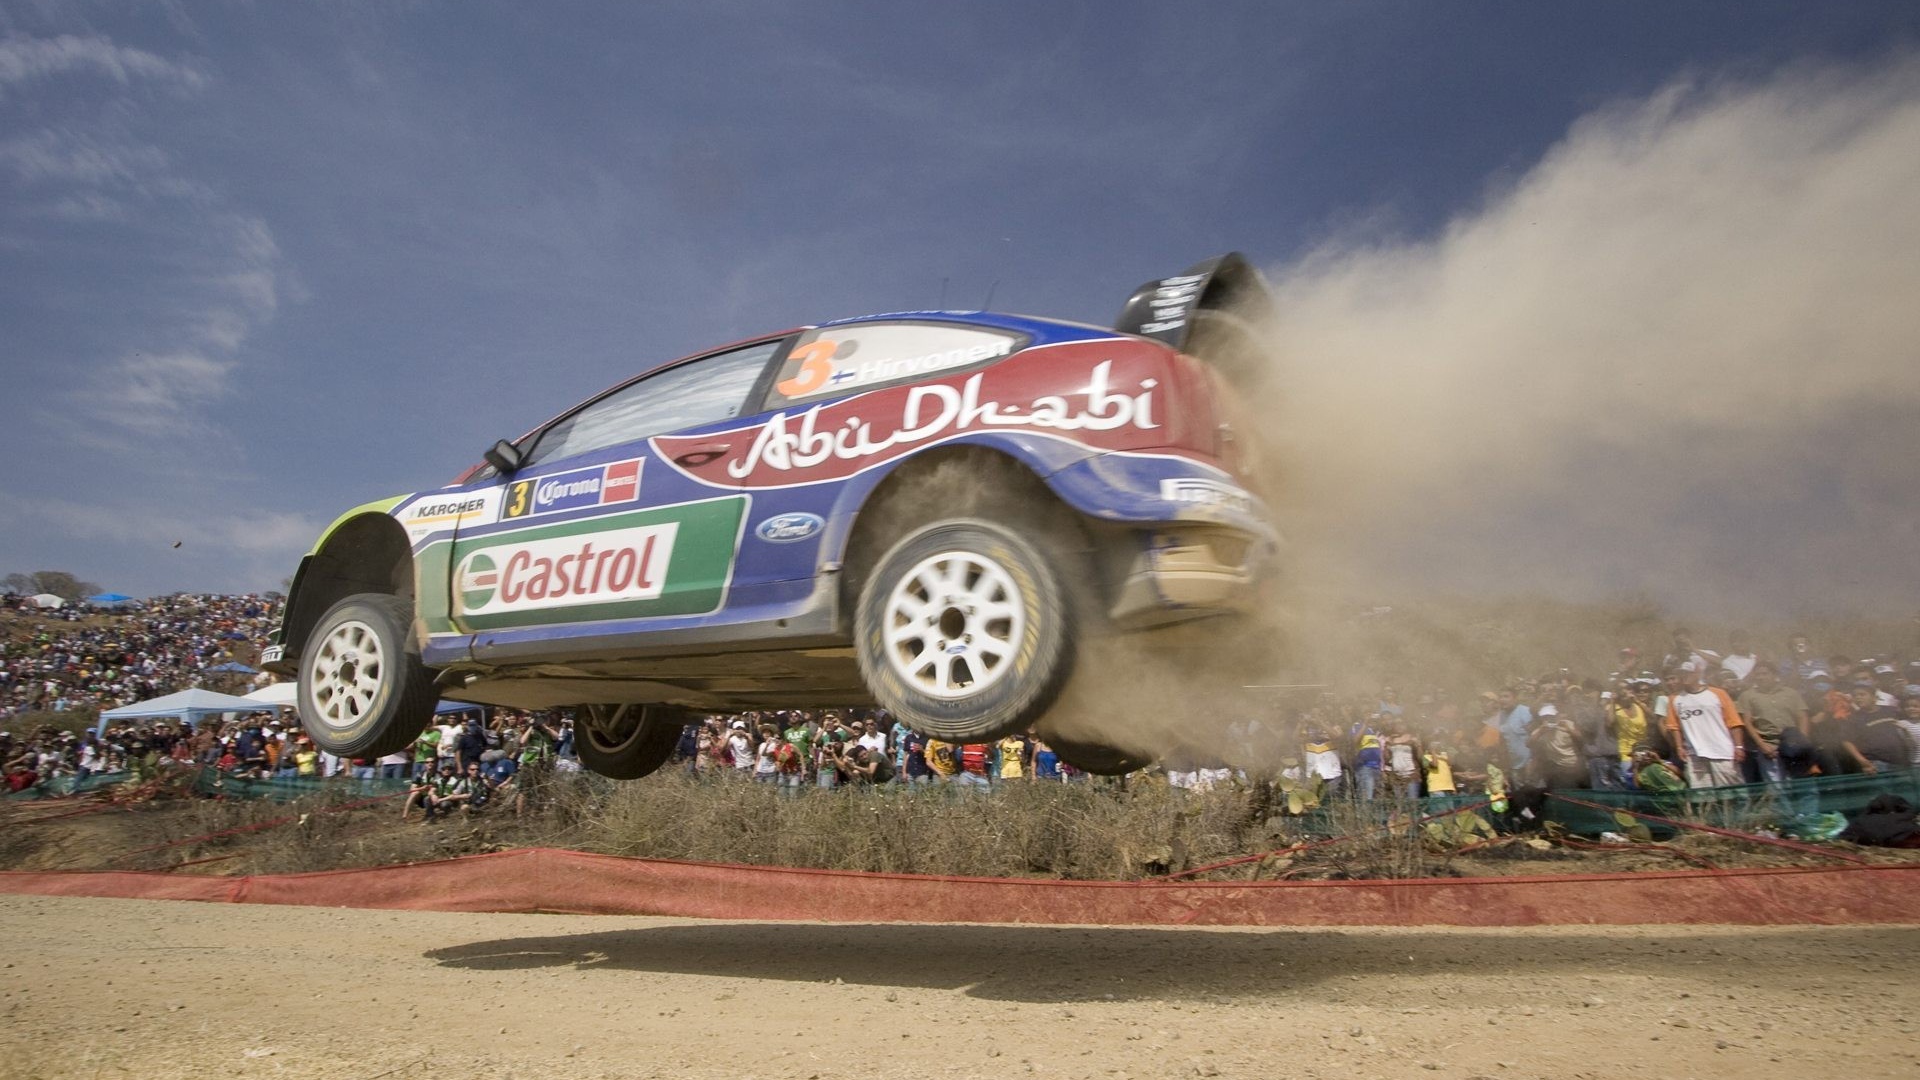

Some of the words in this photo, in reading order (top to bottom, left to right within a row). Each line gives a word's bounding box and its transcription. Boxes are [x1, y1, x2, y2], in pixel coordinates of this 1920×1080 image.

[777, 340, 838, 396] 3
[856, 337, 1015, 382] Hirvonen
[895, 360, 1160, 442] Dhabi
[509, 481, 529, 516] 3
[537, 478, 600, 506] Corona
[501, 534, 657, 604] Castrol
